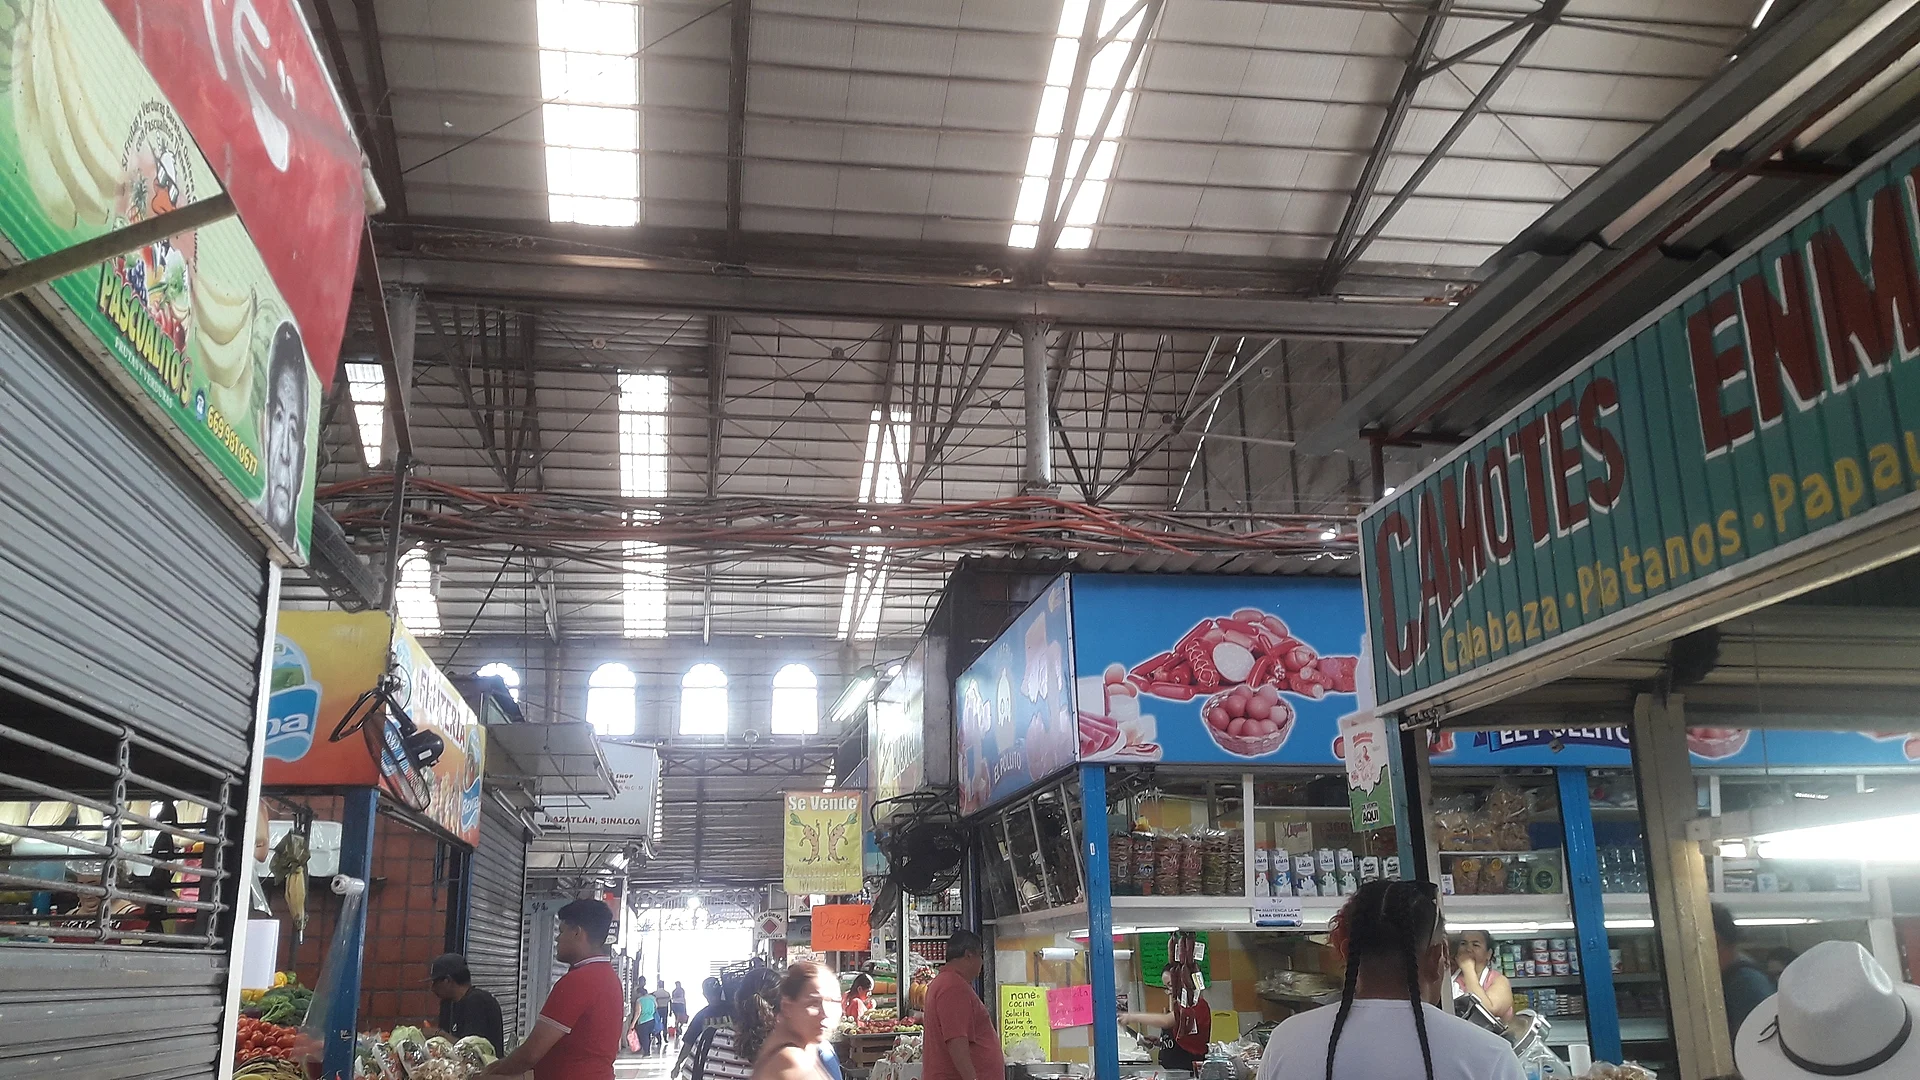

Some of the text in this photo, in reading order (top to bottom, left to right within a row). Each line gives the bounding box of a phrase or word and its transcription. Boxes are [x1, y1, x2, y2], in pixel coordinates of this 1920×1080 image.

[207, 404, 224, 440] 669
[224, 423, 239, 457] 981
[1376, 166, 1920, 676] CAMOTES ENM
[1441, 510, 1743, 673] Calabaza Platanos
[600, 816, 642, 826] SINALOA
[788, 795, 858, 811] Se Vende
